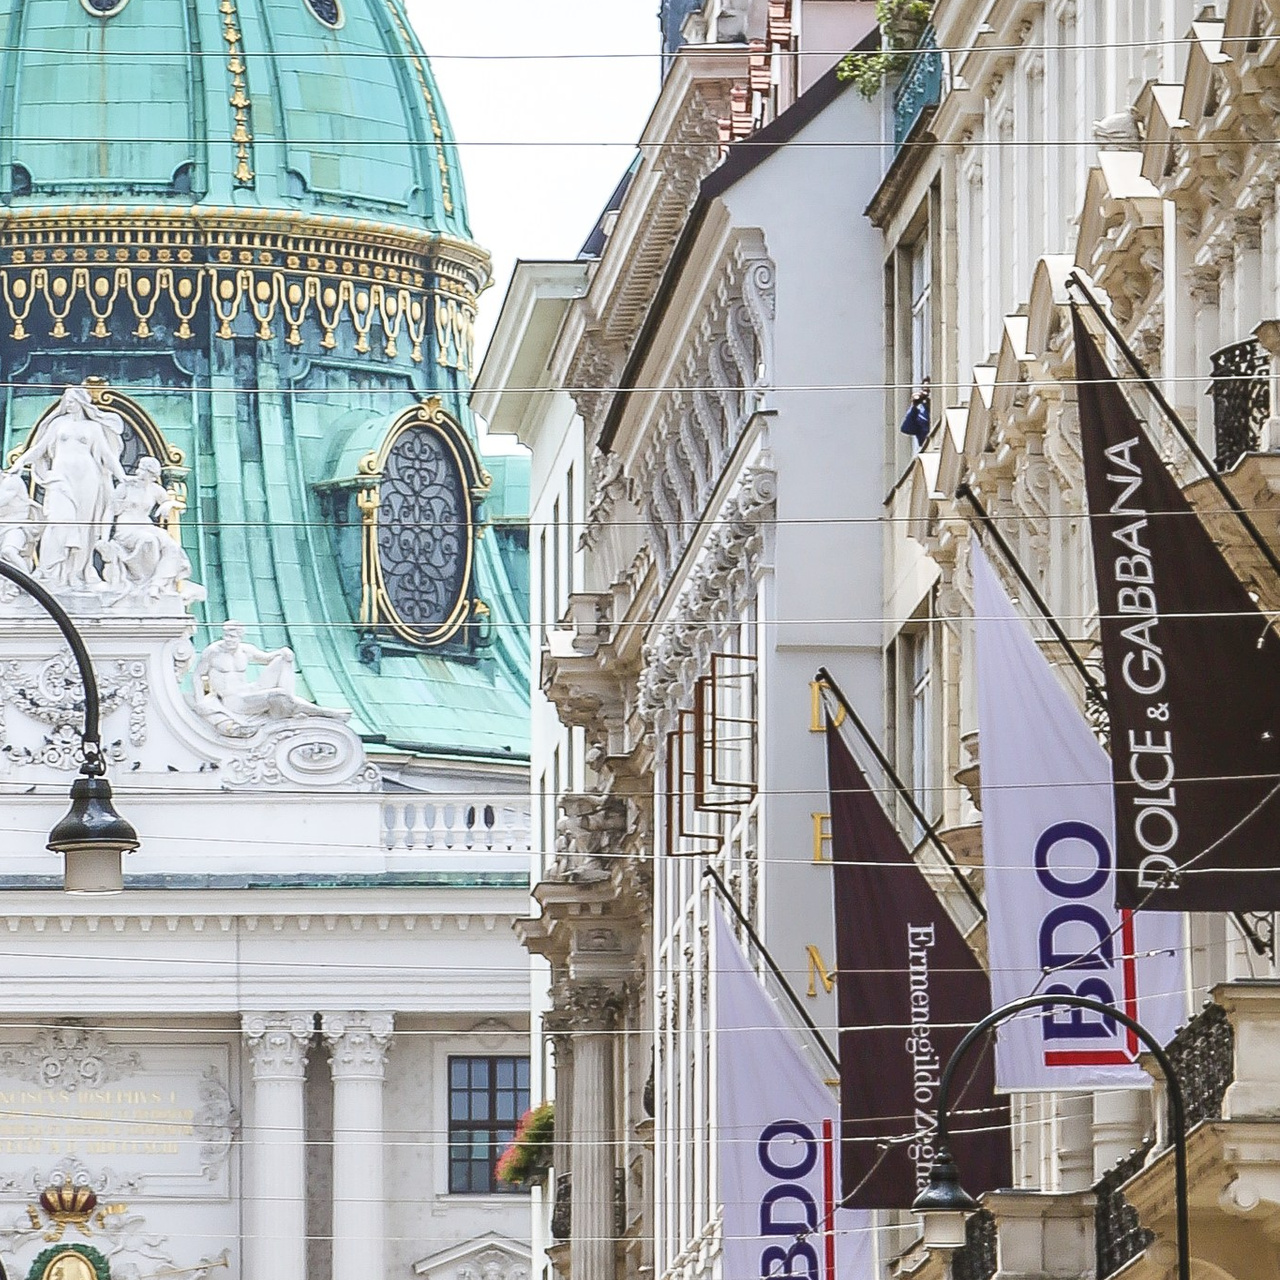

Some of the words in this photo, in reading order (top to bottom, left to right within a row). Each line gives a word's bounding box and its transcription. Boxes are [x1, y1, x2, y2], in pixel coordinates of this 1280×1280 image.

[1104, 436, 1166, 695] GABBANA
[1147, 702, 1170, 722] &
[1128, 729, 1179, 889] DOLCE
[906, 922, 941, 1104] Ermenegildo
[1034, 820, 1118, 1041] BDO
